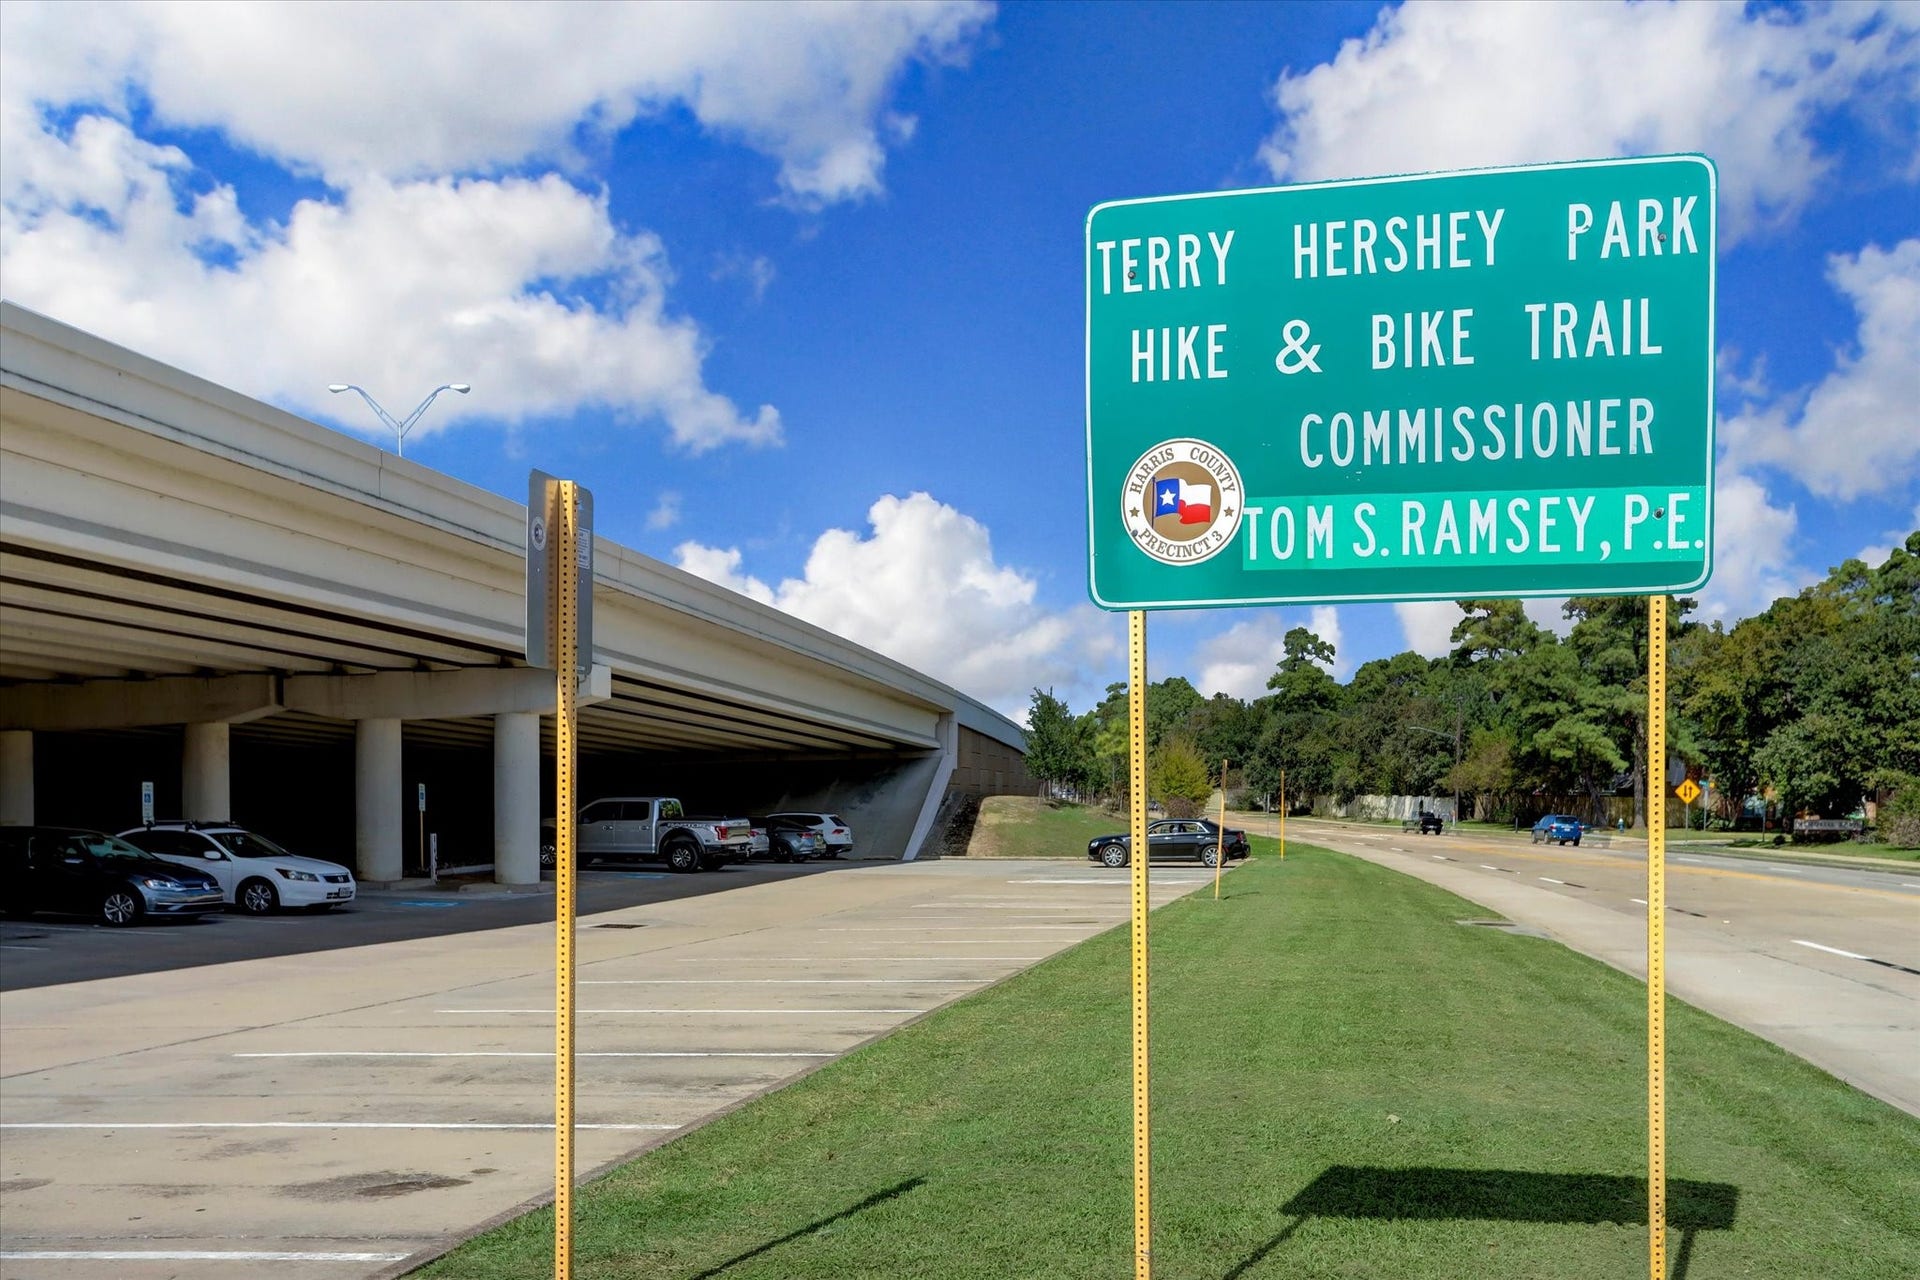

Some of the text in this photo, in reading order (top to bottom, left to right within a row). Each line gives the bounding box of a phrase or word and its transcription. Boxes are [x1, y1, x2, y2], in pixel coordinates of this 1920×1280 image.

[1097, 196, 1699, 295] TERRY HERSHEY PARK
[1131, 298, 1662, 383] HIKE & BIKE TRAIL
[1300, 398, 1655, 468] COMMISSIONER
[1130, 447, 1235, 494] HARRIS COUNTY
[1138, 528, 1223, 557] PRECINCT 3
[1243, 506, 1333, 561] TOM
[1624, 492, 1704, 552] P.E.
